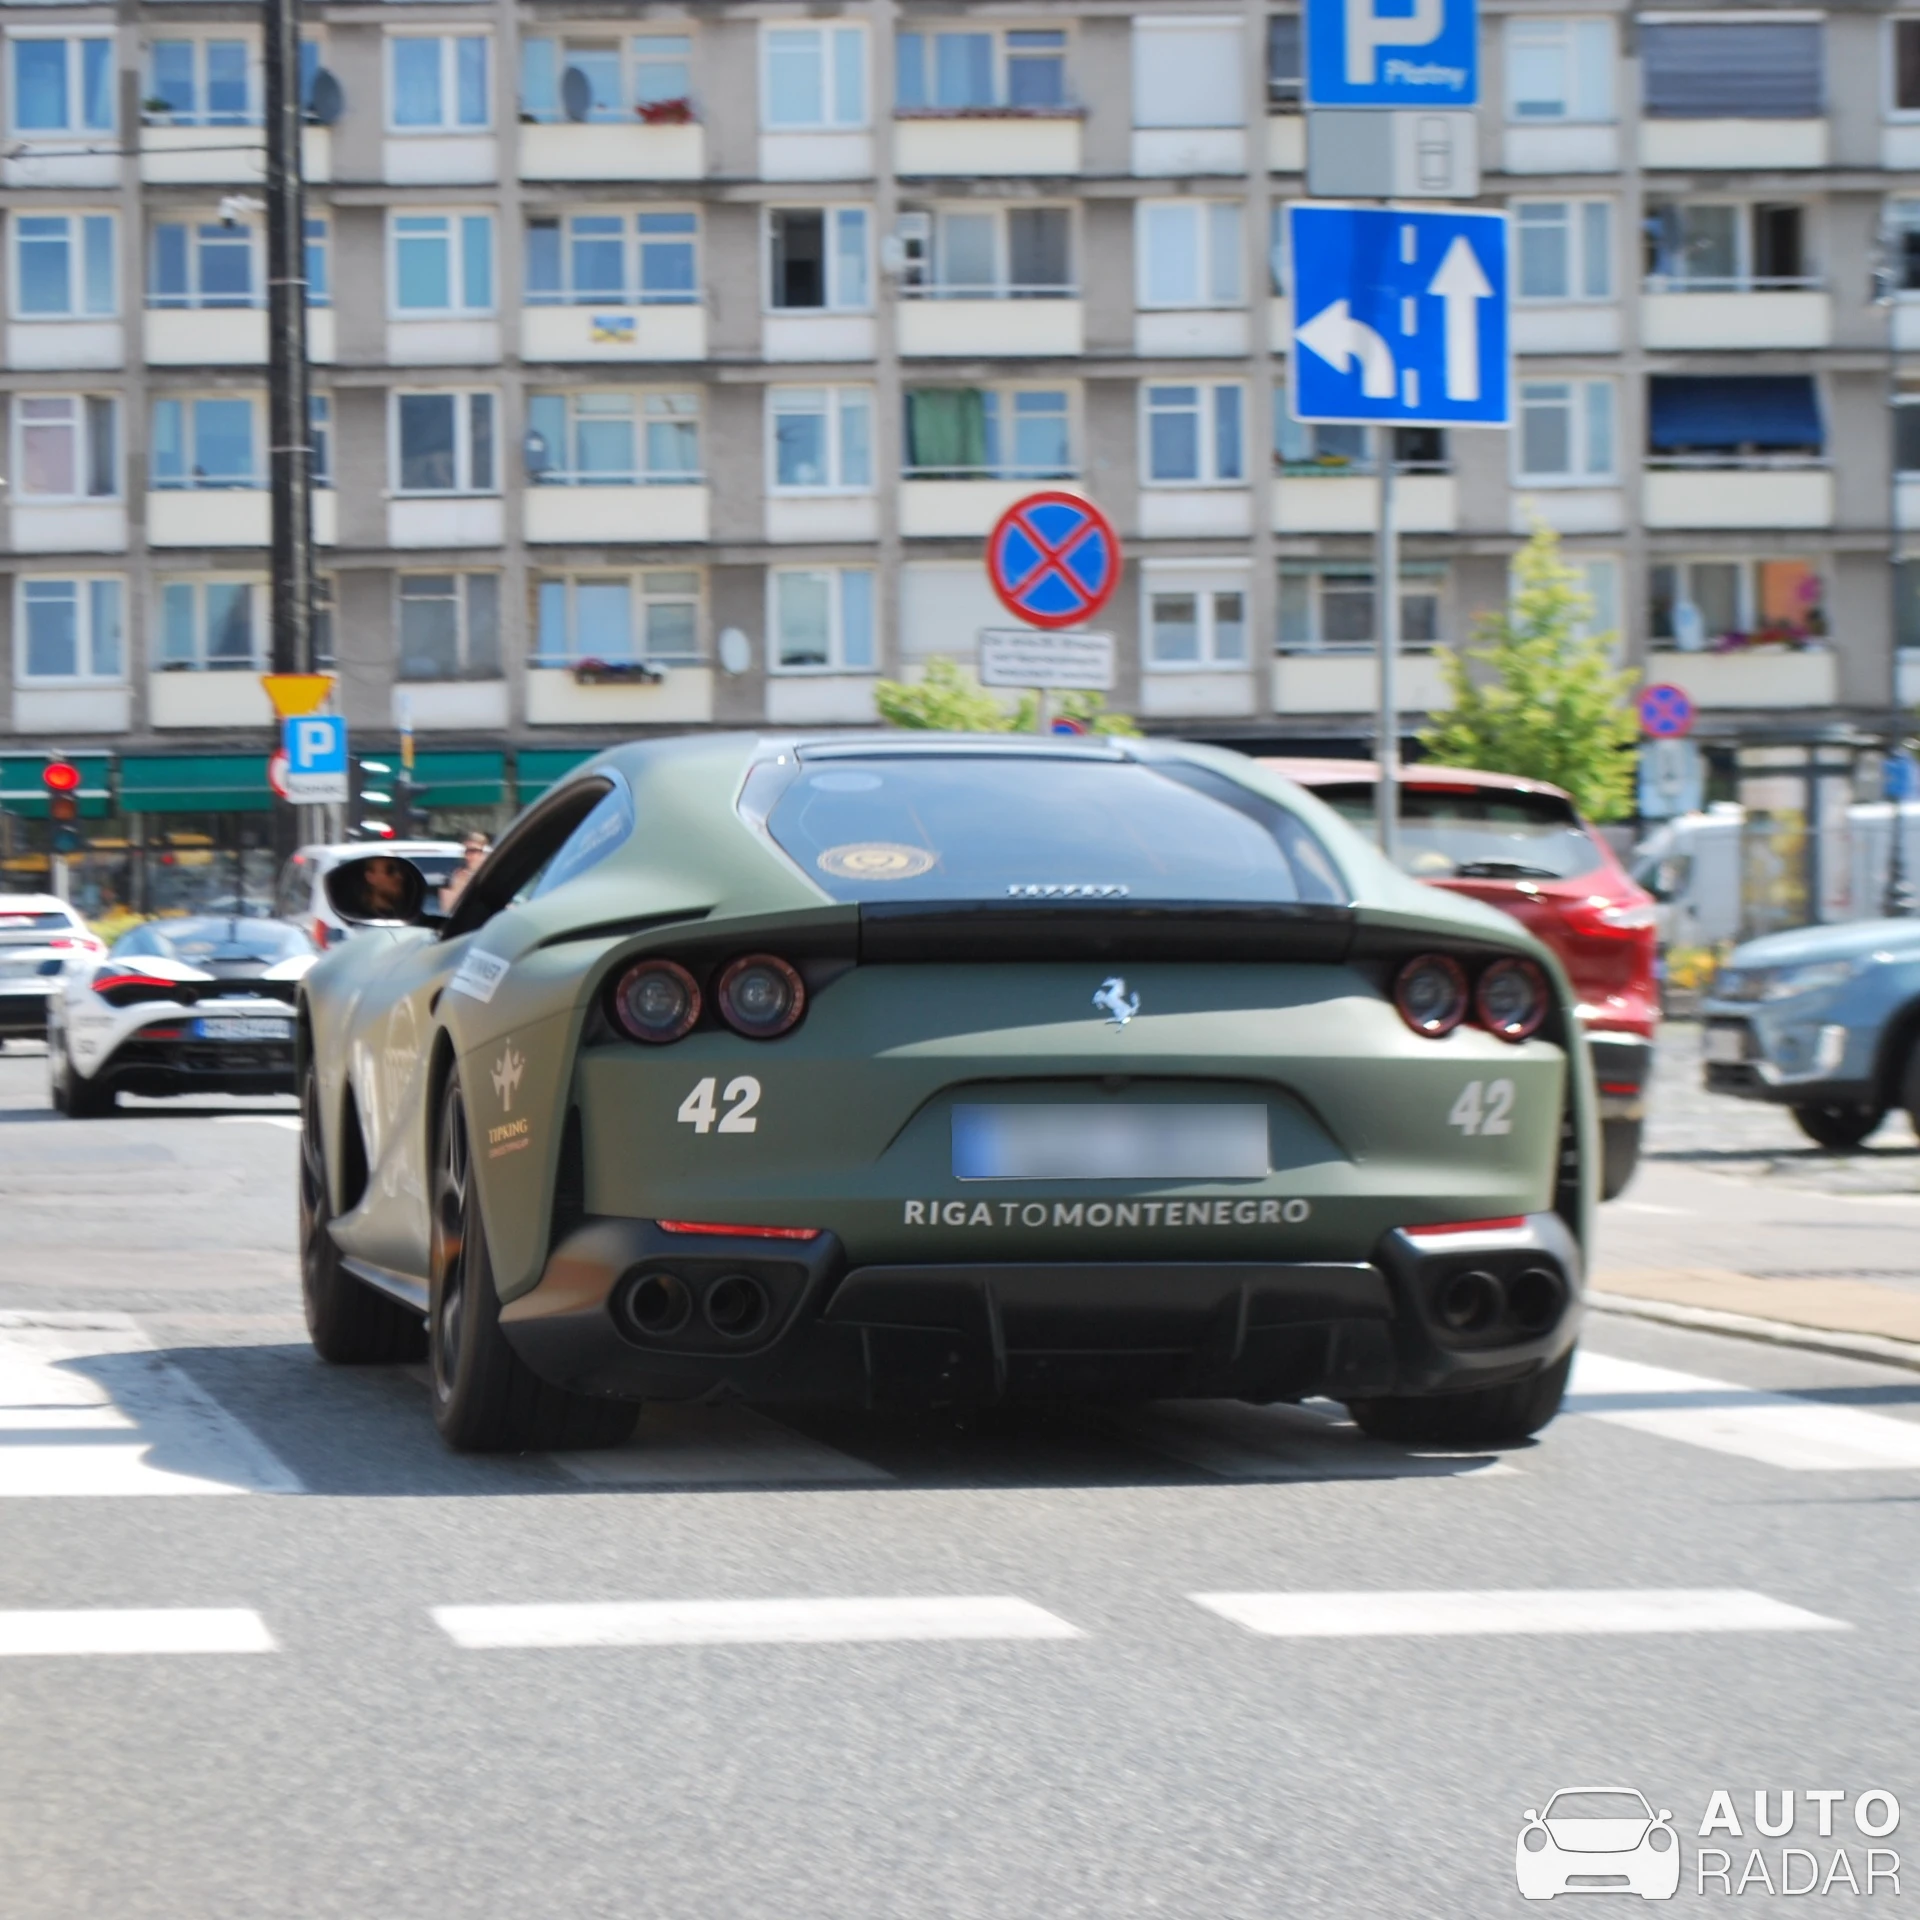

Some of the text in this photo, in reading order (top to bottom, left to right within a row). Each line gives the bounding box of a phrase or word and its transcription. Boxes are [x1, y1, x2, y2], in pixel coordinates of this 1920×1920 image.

[1346, 0, 1443, 84] P
[297, 720, 335, 768] P
[677, 1076, 761, 1133] 42
[1447, 1079, 1515, 1136] 42
[904, 1199, 1311, 1227] RIGA TO MONTENEGRO
